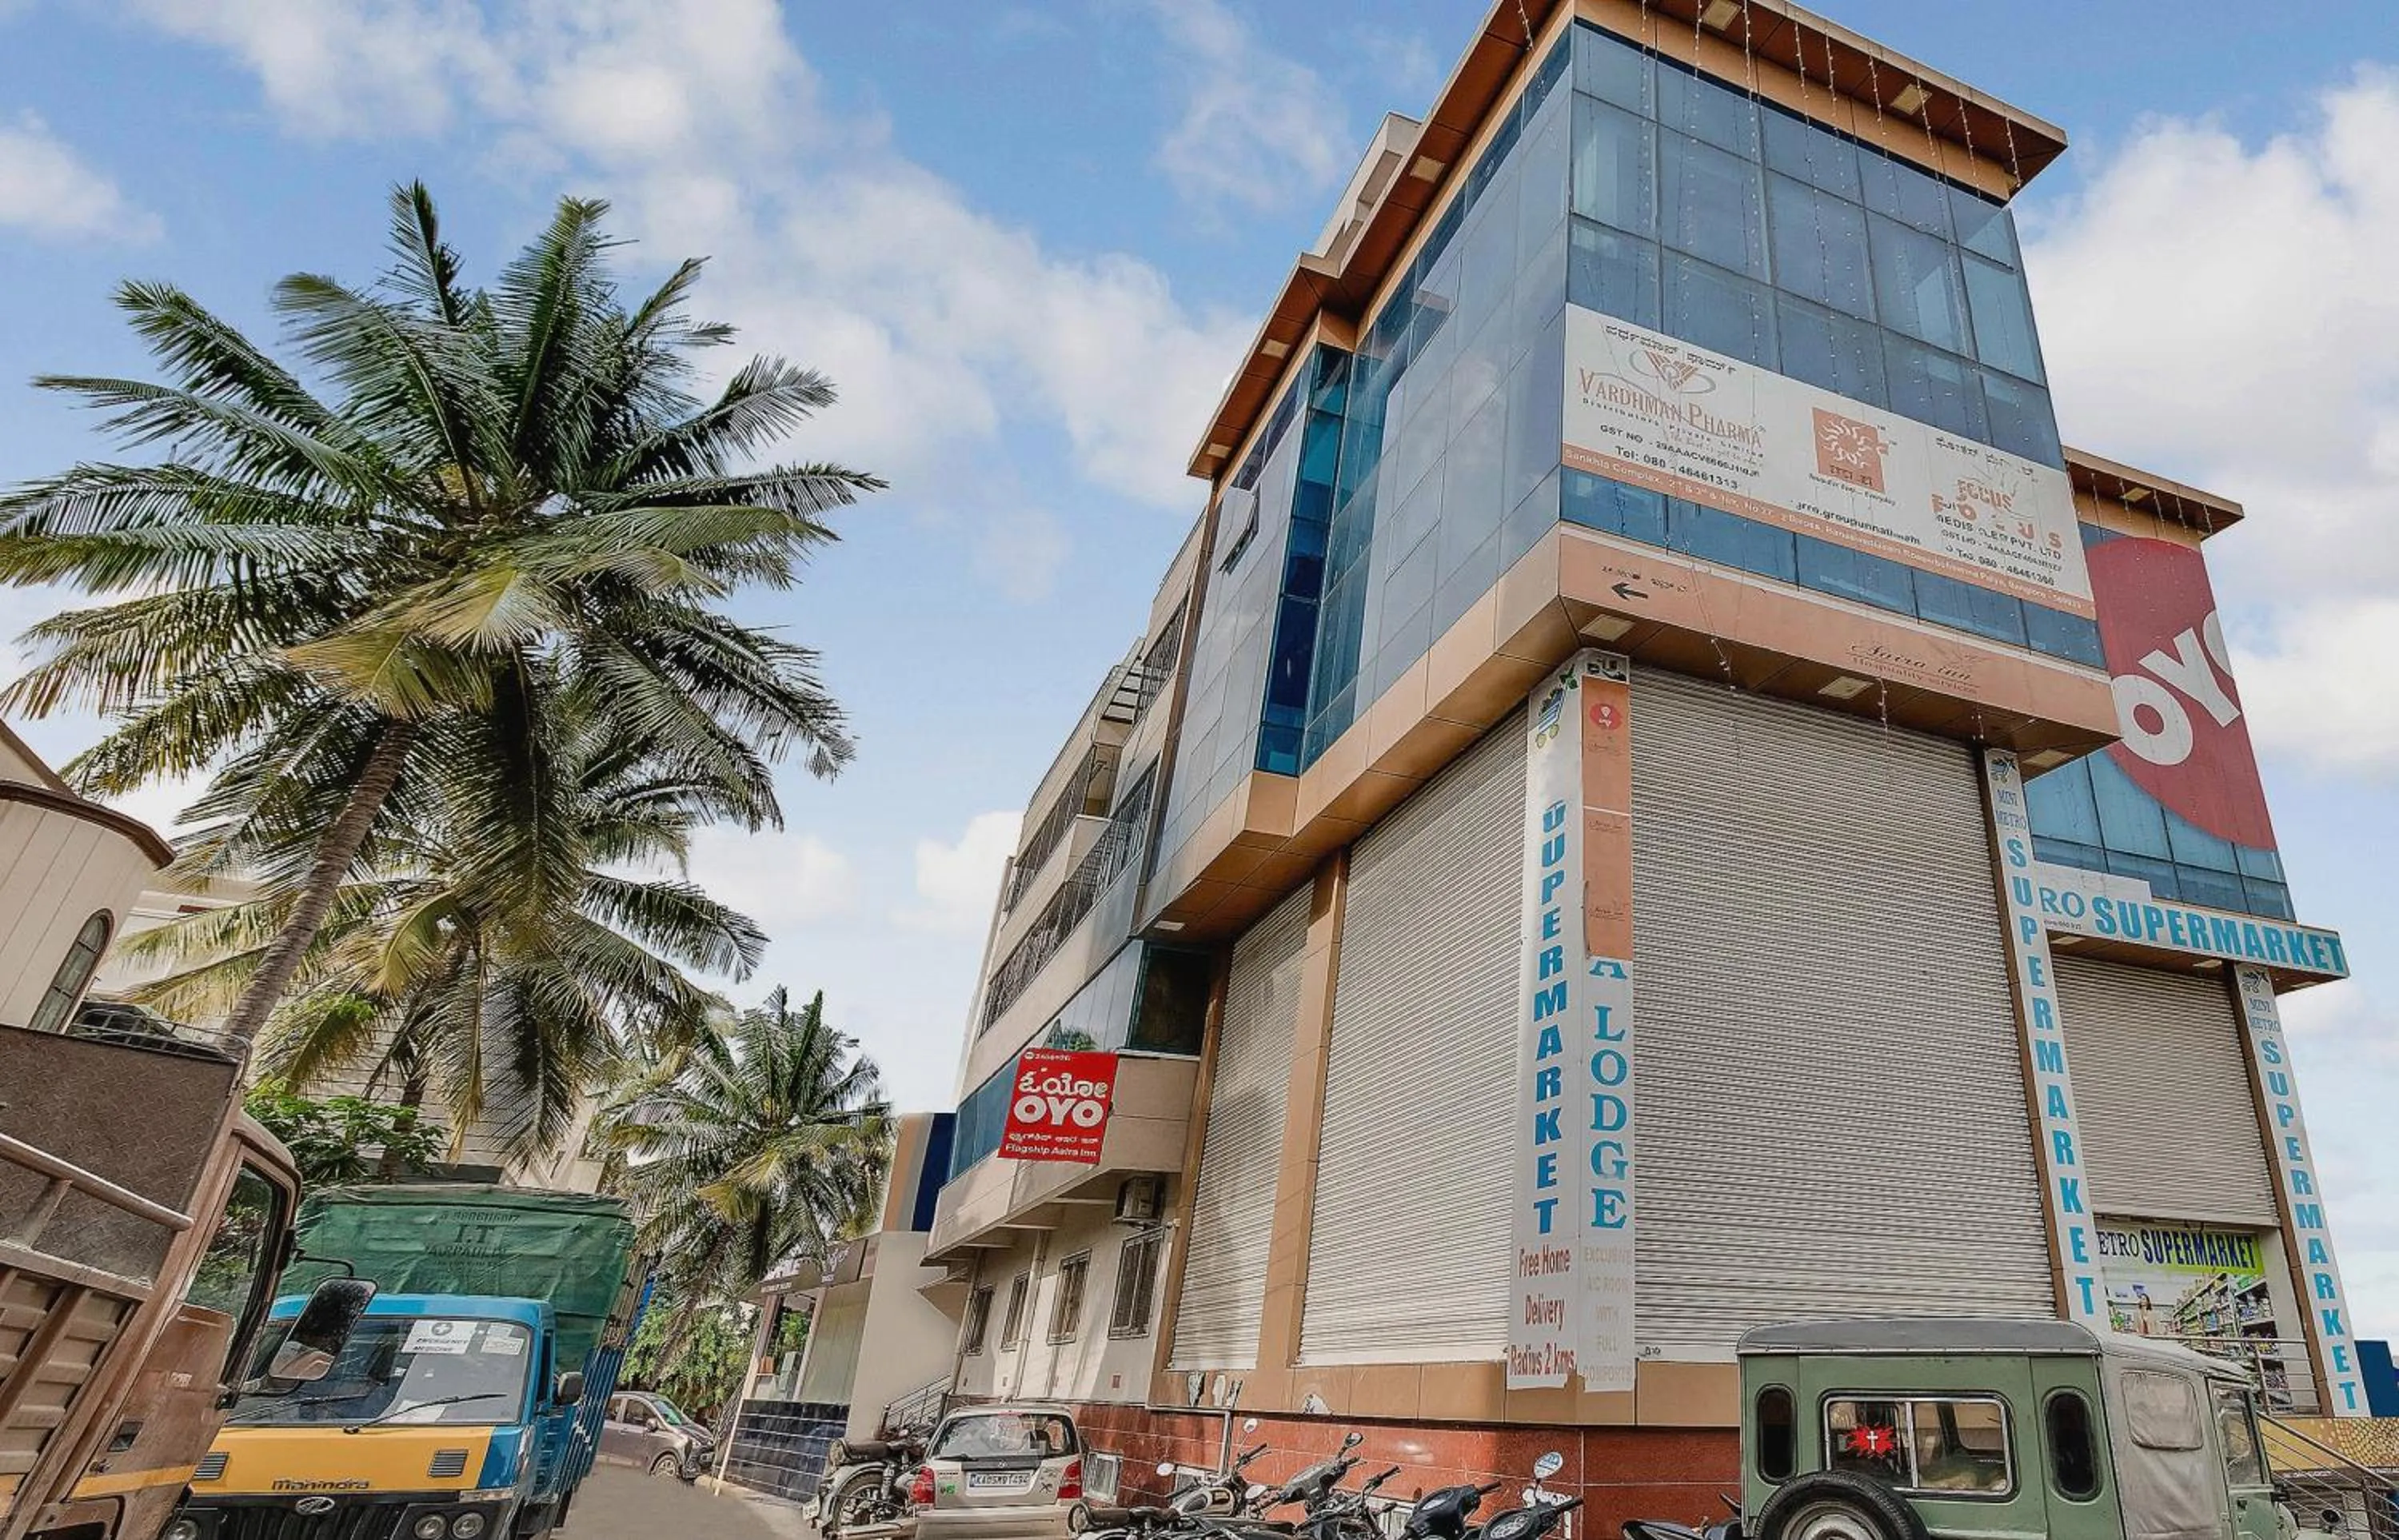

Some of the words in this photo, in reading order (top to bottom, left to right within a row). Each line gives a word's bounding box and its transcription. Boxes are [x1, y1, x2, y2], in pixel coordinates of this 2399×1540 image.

[1600, 424, 1623, 437] GST
[1626, 433, 1643, 445] NO
[2091, 896, 2345, 973] SUPERMARKET
[2006, 839, 2094, 1315] SUPERMARKET
[1013, 1095, 1104, 1128] OYO
[1589, 1004, 1629, 1230] LODGE
[1005, 1143, 1051, 1155] Flagship
[2263, 1039, 2357, 1410] SUPERMARKET
[1519, 1247, 1539, 1279] Free
[1543, 1243, 1571, 1275] Home
[2096, 1231, 2139, 1257] ETRO
[2140, 1229, 2257, 1269] SUPERMARKET
[1525, 1293, 1565, 1331] Delivery
